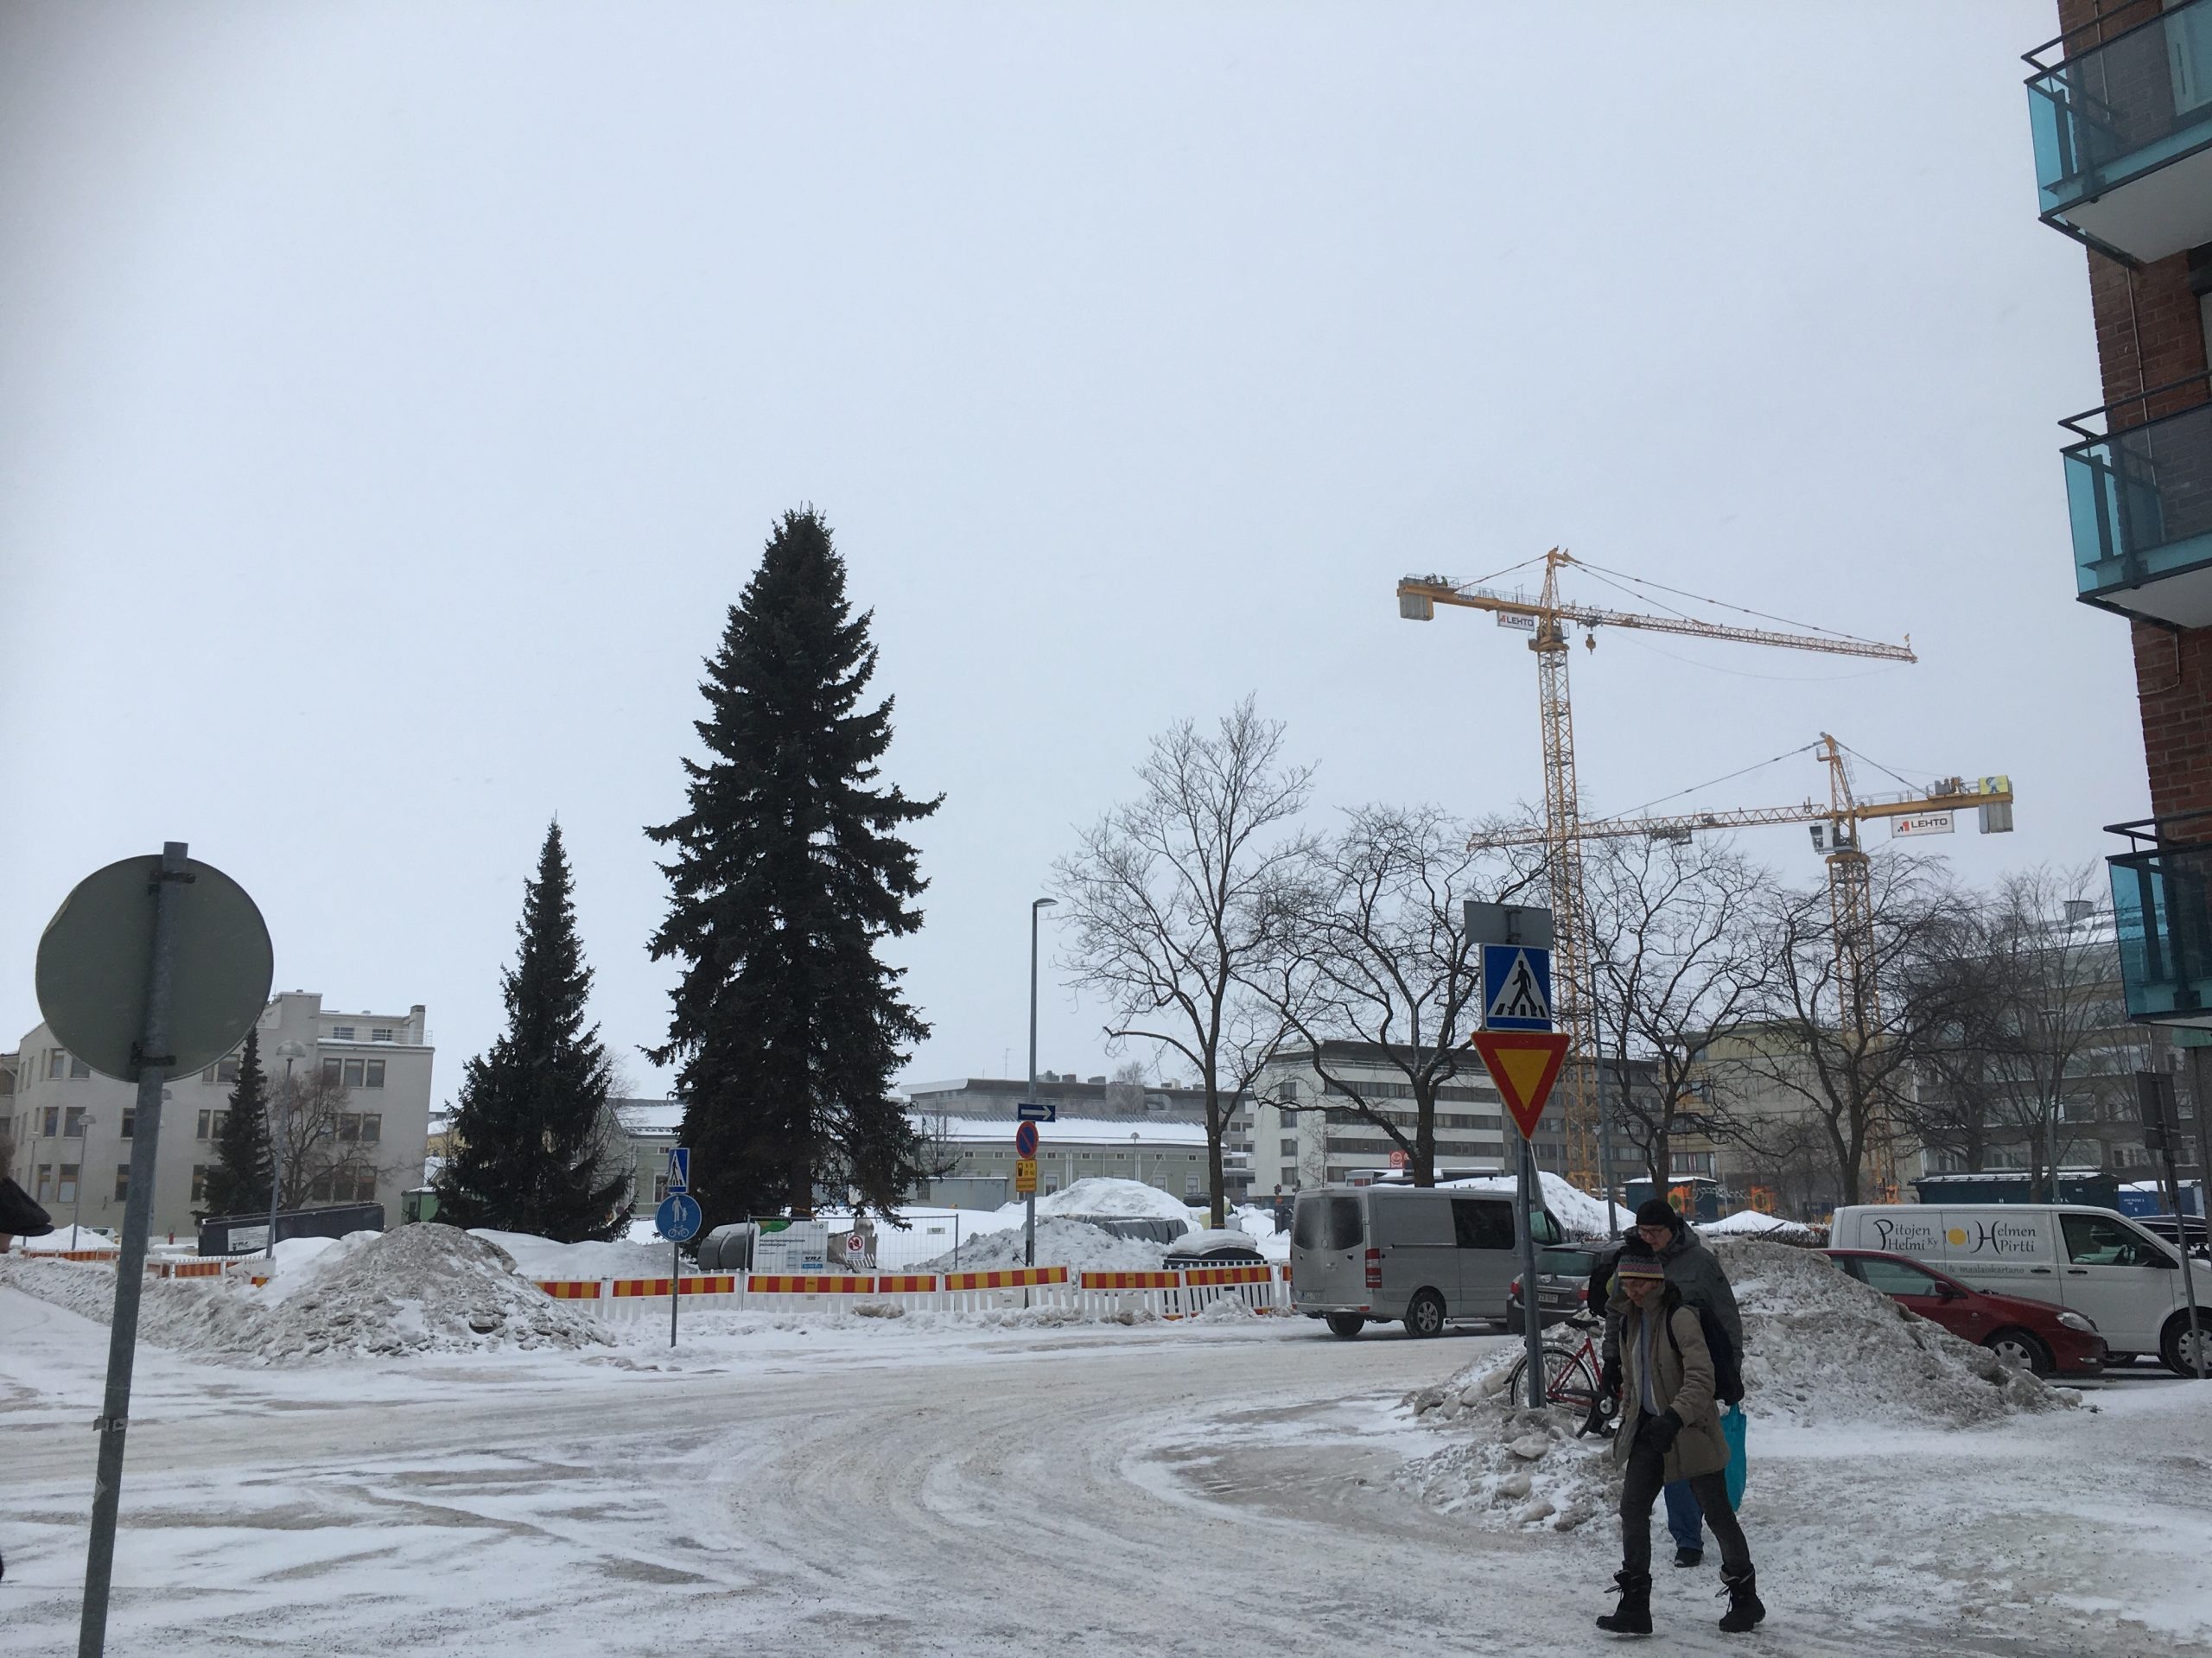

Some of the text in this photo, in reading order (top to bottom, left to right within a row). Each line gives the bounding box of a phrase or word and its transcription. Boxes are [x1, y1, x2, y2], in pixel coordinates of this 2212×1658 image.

[1506, 616, 1534, 626] LEHTO
[1910, 818, 1948, 827] LEHTO
[1873, 1219, 1930, 1250] Pitojen
[1970, 1220, 2037, 1255] Helmen
[1888, 1237, 1938, 1251] Helmi Ky
[2000, 1240, 2035, 1252] Pirtti
